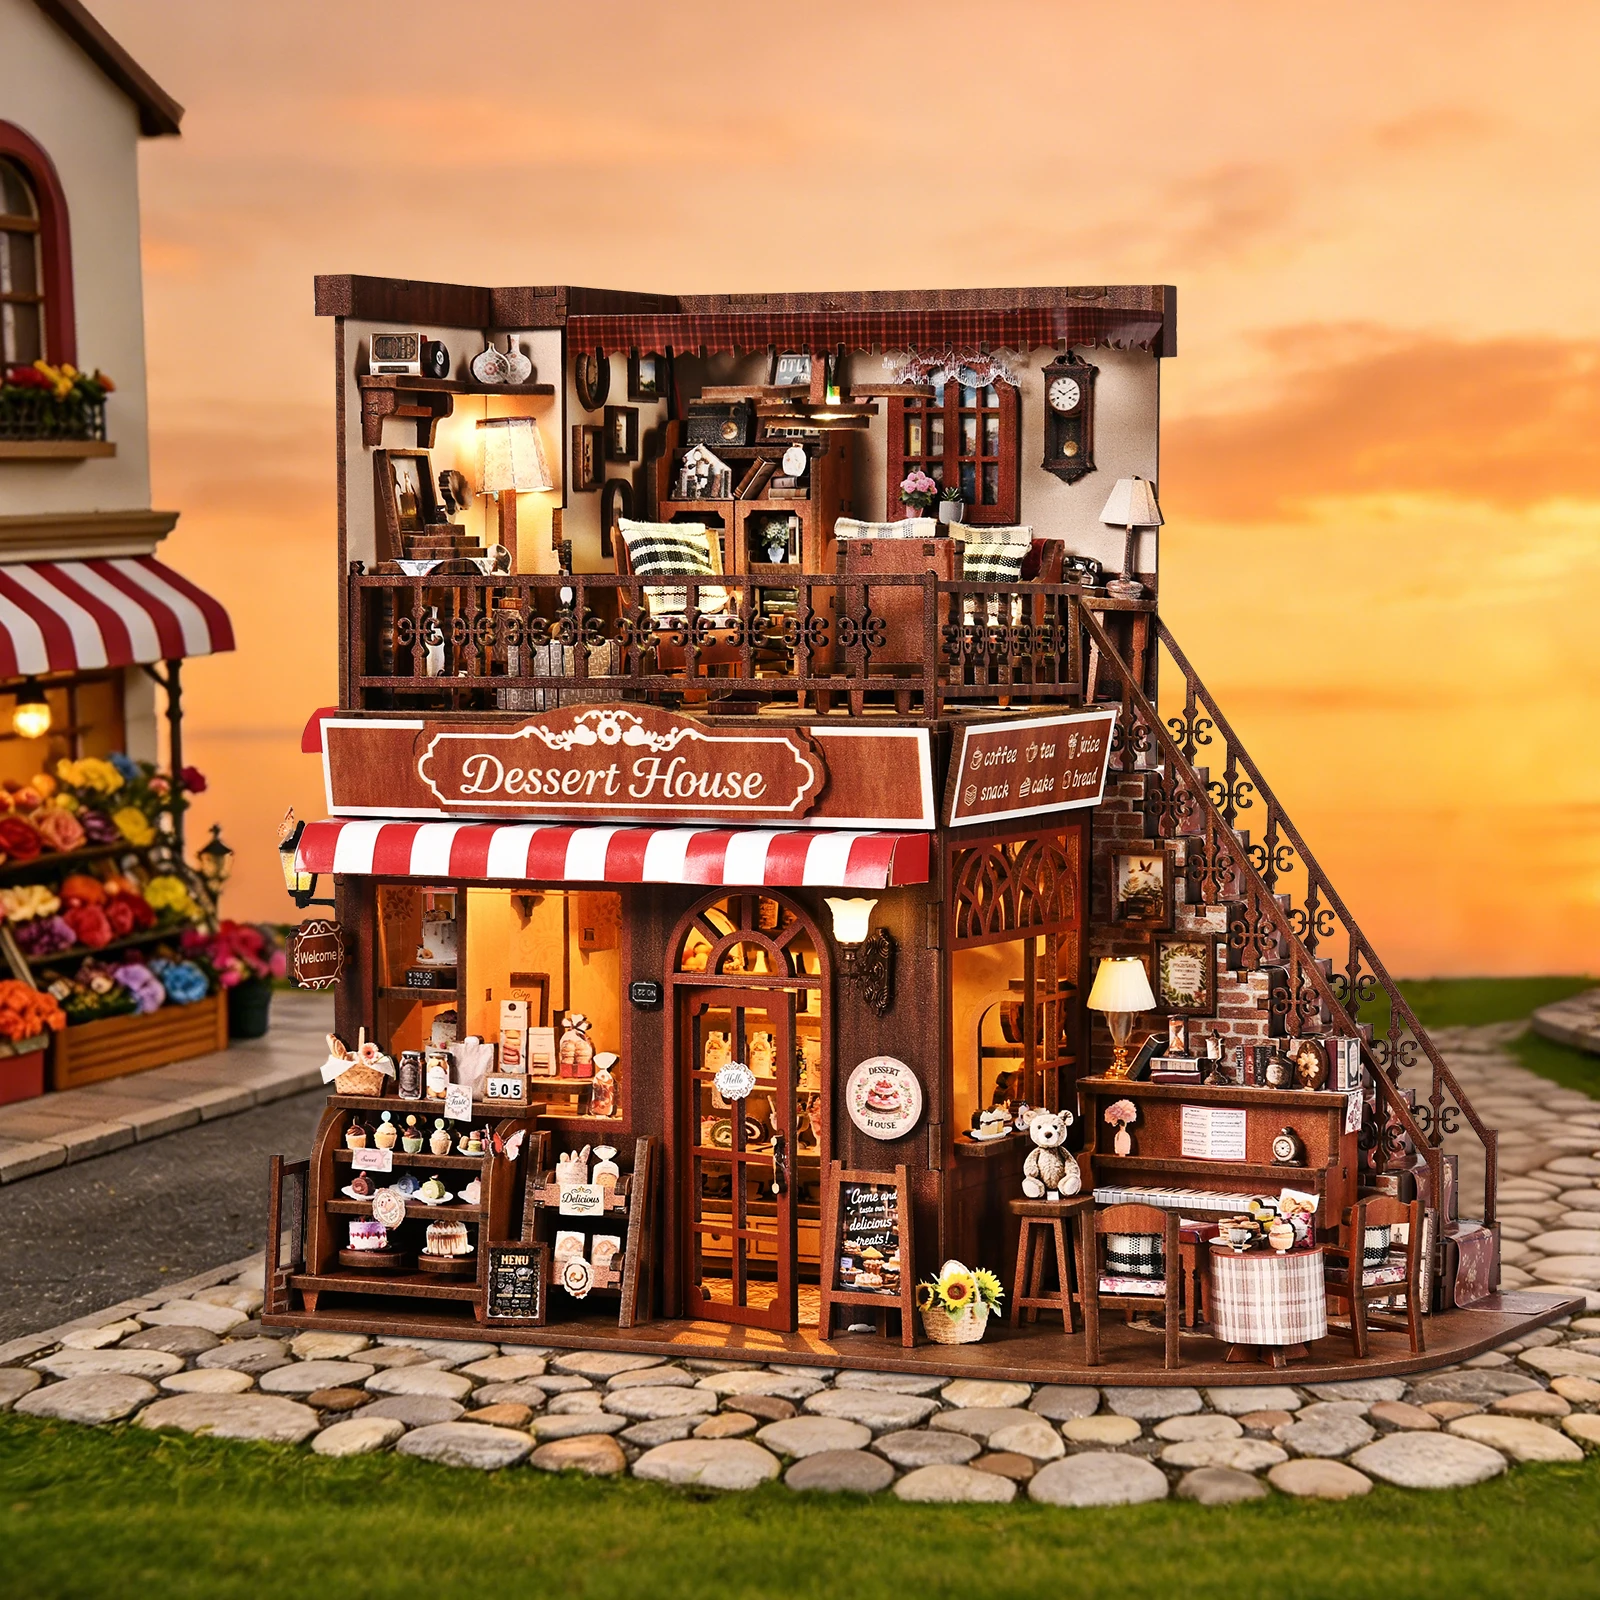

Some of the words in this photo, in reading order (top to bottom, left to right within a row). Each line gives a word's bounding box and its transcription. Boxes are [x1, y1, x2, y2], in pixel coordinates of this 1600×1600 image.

[984, 746, 1017, 766] coffee
[1040, 742, 1055, 759] tea
[1077, 735, 1100, 757] juice
[459, 754, 621, 796] Dessert
[628, 756, 767, 799] House
[980, 779, 1009, 801] snack
[1031, 774, 1054, 794] cake
[1072, 767, 1098, 788] bread
[300, 950, 337, 964] Welcome
[869, 1066, 900, 1076] DESSERT
[723, 1073, 743, 1084] Hello
[450, 1095, 466, 1106] Taste
[867, 1120, 897, 1129] HOUSE
[561, 1192, 600, 1203] Delicious
[851, 1188, 878, 1204] Come
[880, 1190, 897, 1201] and
[850, 1217, 892, 1231] delicious
[856, 1231, 890, 1246] treats!
[501, 1255, 529, 1265] MENU
